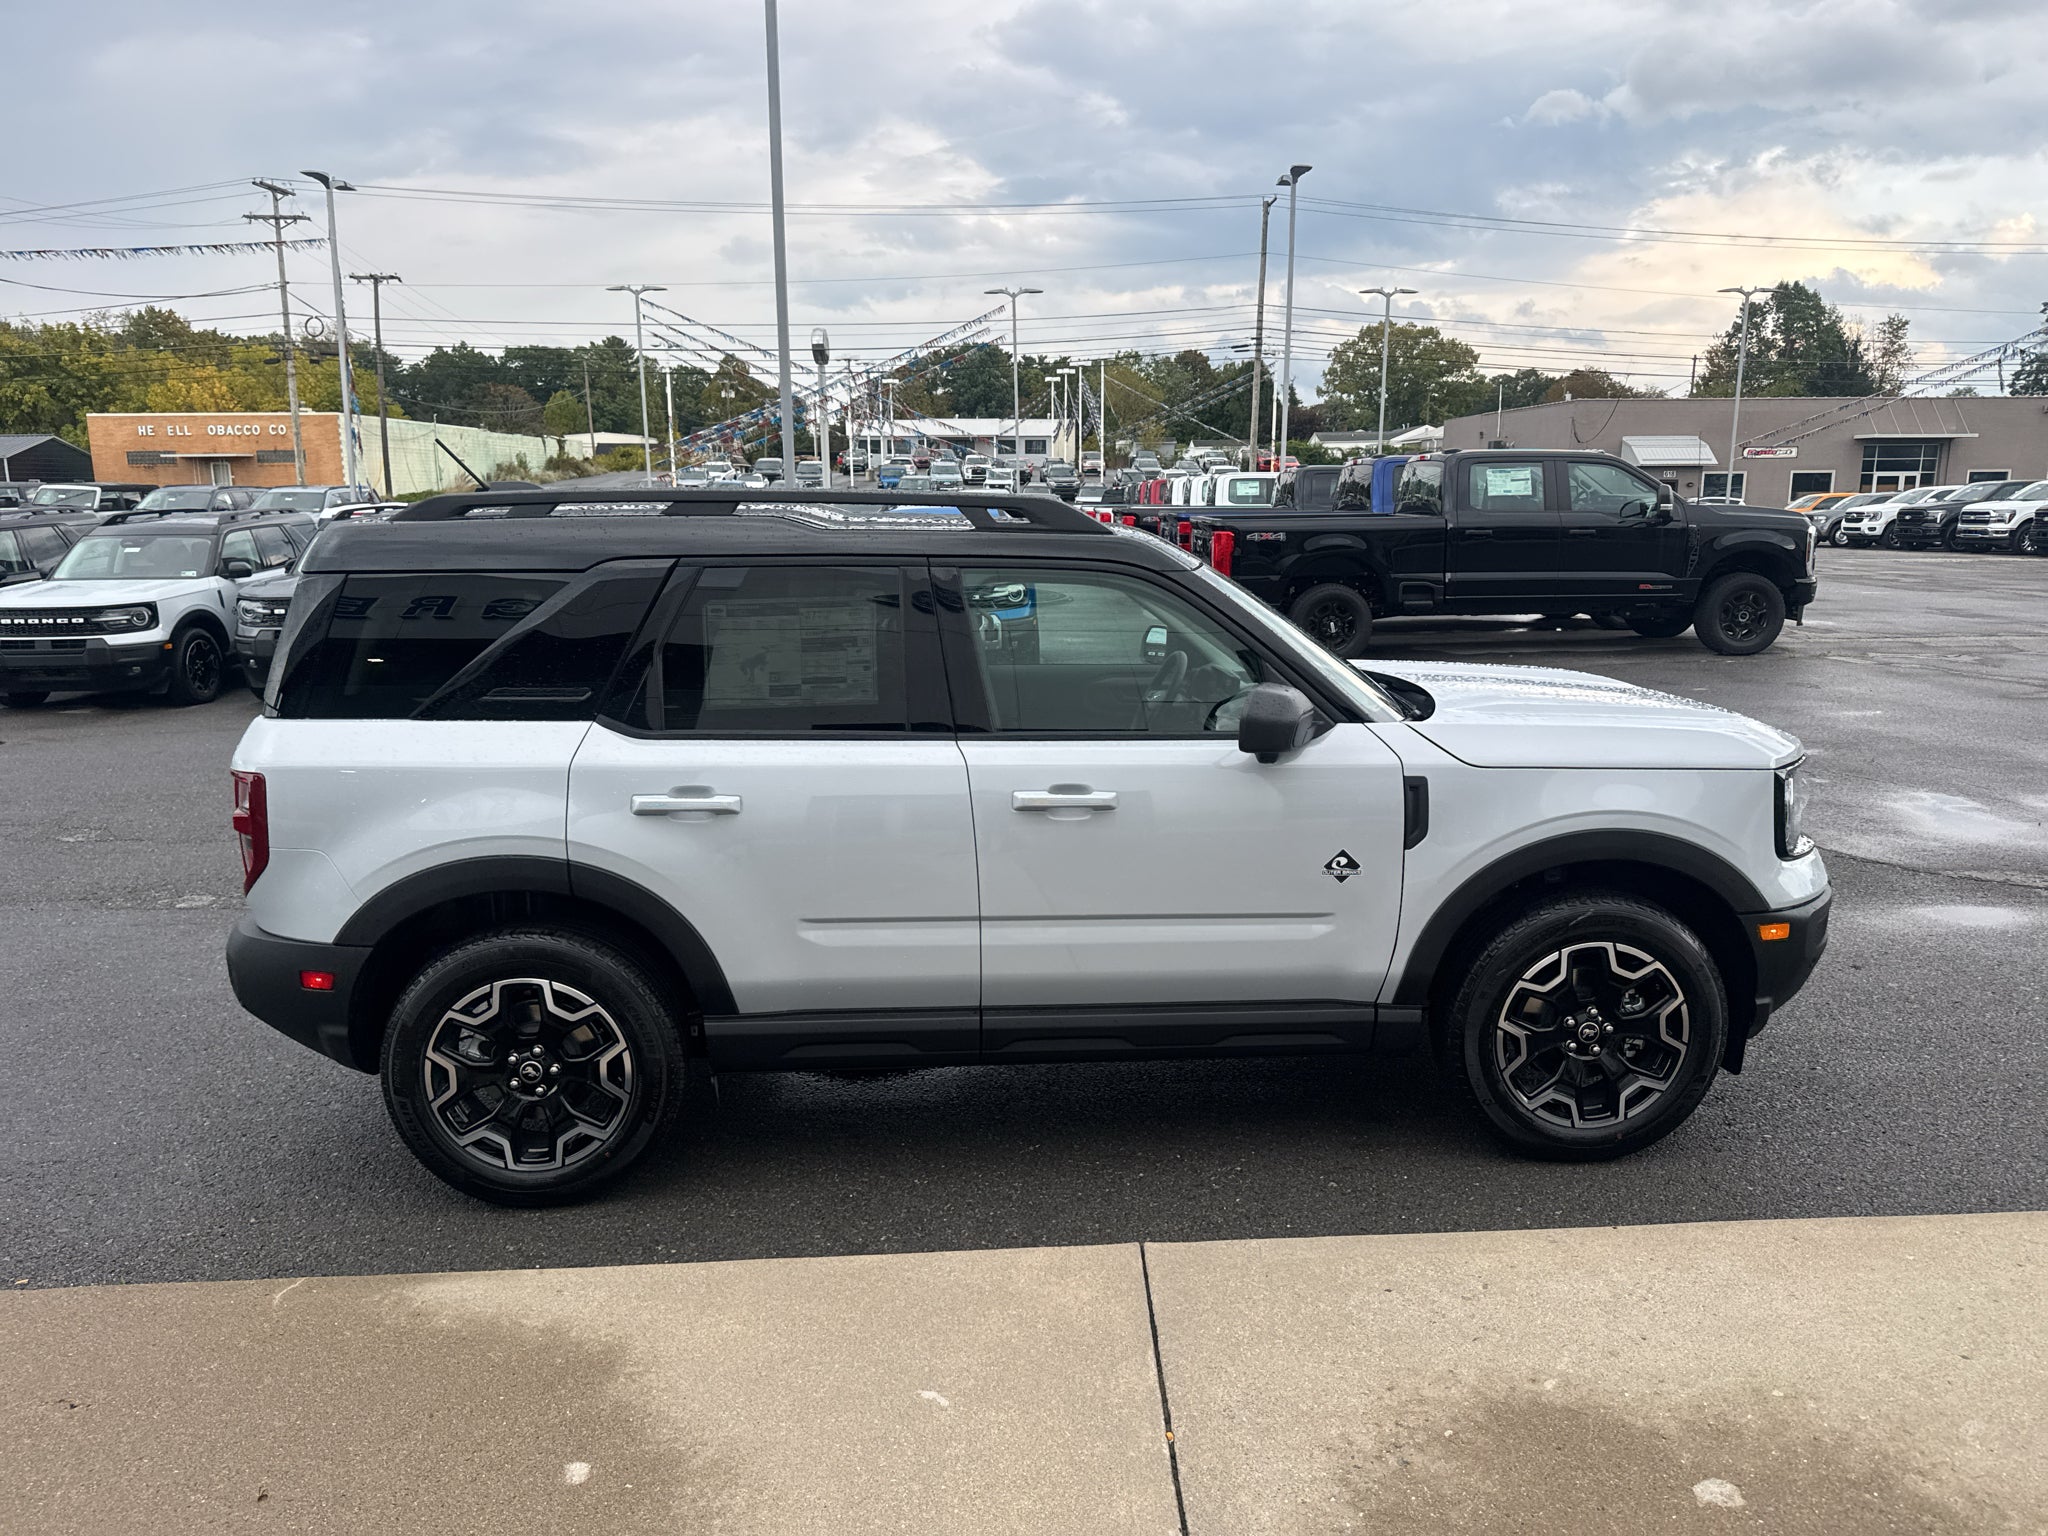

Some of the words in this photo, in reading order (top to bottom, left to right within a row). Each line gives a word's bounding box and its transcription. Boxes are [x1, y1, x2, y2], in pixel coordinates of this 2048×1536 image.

[138, 425, 155, 436] HE
[167, 425, 192, 436] ELL
[207, 424, 261, 436] OBACCO
[268, 424, 287, 436] CO
[0, 617, 85, 625] BRONCO
